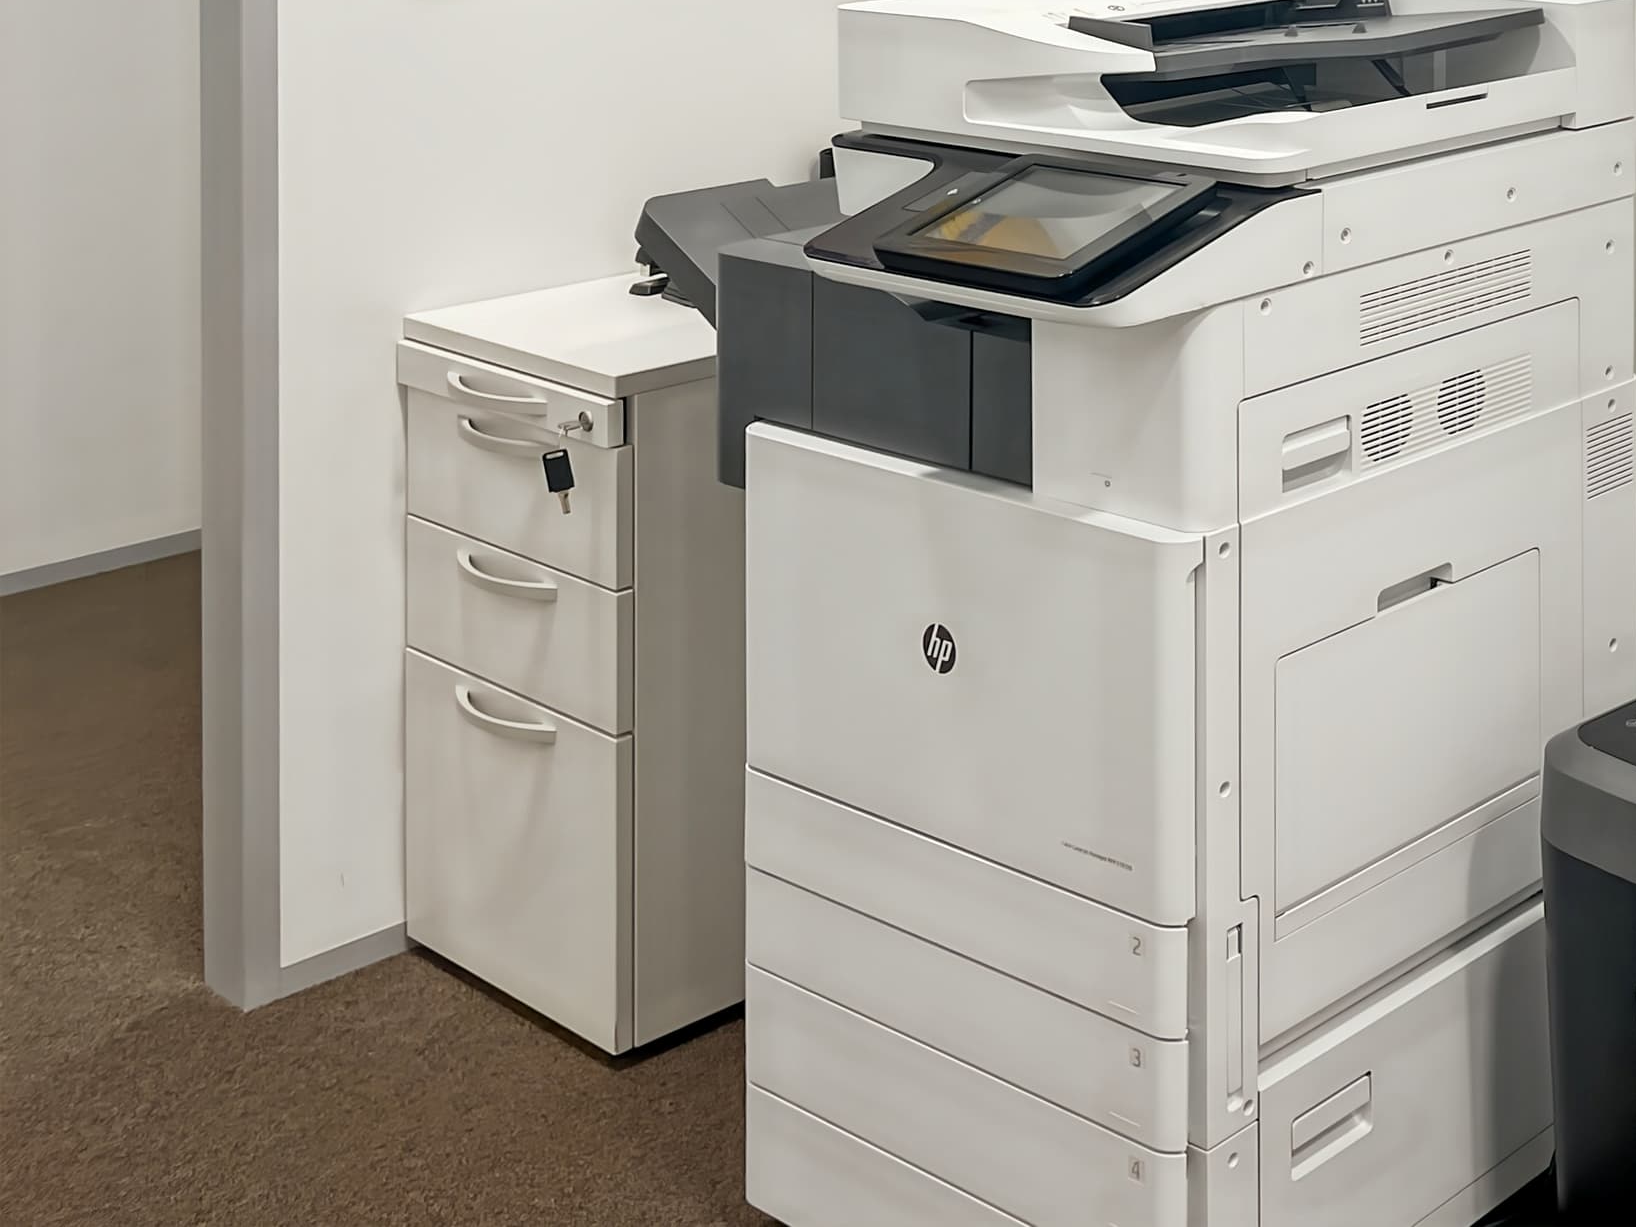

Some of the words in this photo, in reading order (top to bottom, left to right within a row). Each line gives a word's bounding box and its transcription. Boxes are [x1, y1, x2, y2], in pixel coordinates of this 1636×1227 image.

[925, 623, 954, 673] hp
[1133, 937, 1142, 956] 2
[1133, 1048, 1141, 1067] 3
[1132, 1161, 1140, 1179] 4
